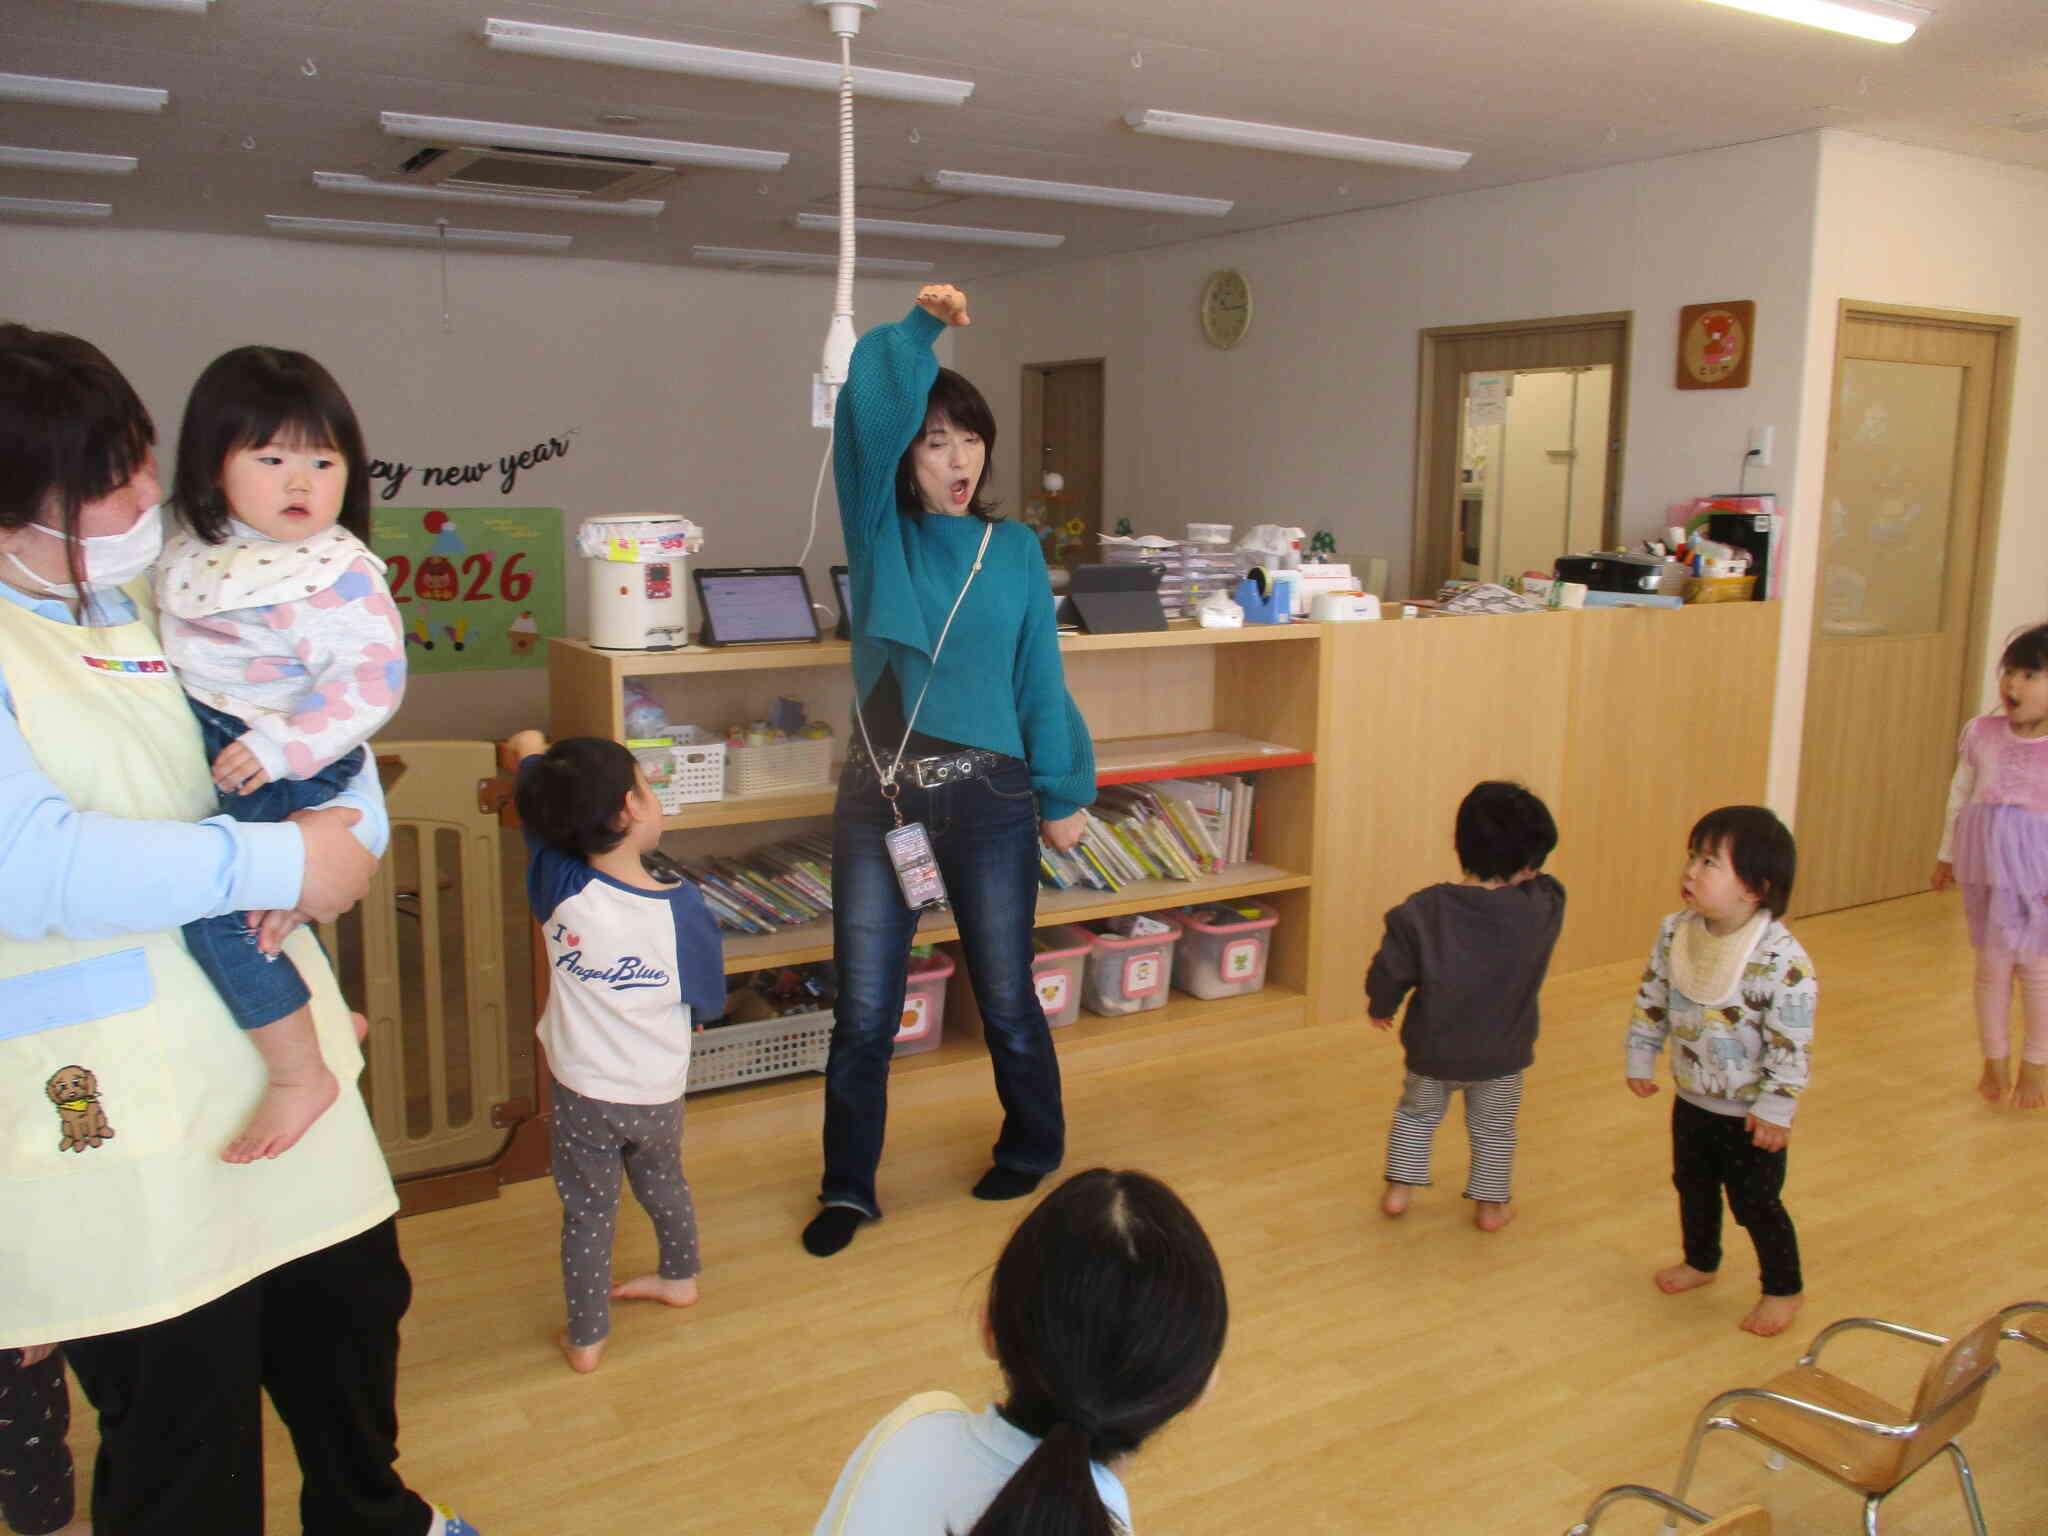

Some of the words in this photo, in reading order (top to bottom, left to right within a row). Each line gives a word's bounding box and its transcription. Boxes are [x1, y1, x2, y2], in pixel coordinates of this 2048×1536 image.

[423, 462, 492, 486] new
[500, 437, 570, 494] year
[552, 923, 567, 943] I
[556, 950, 617, 982] Angel
[613, 956, 669, 985] Blue
